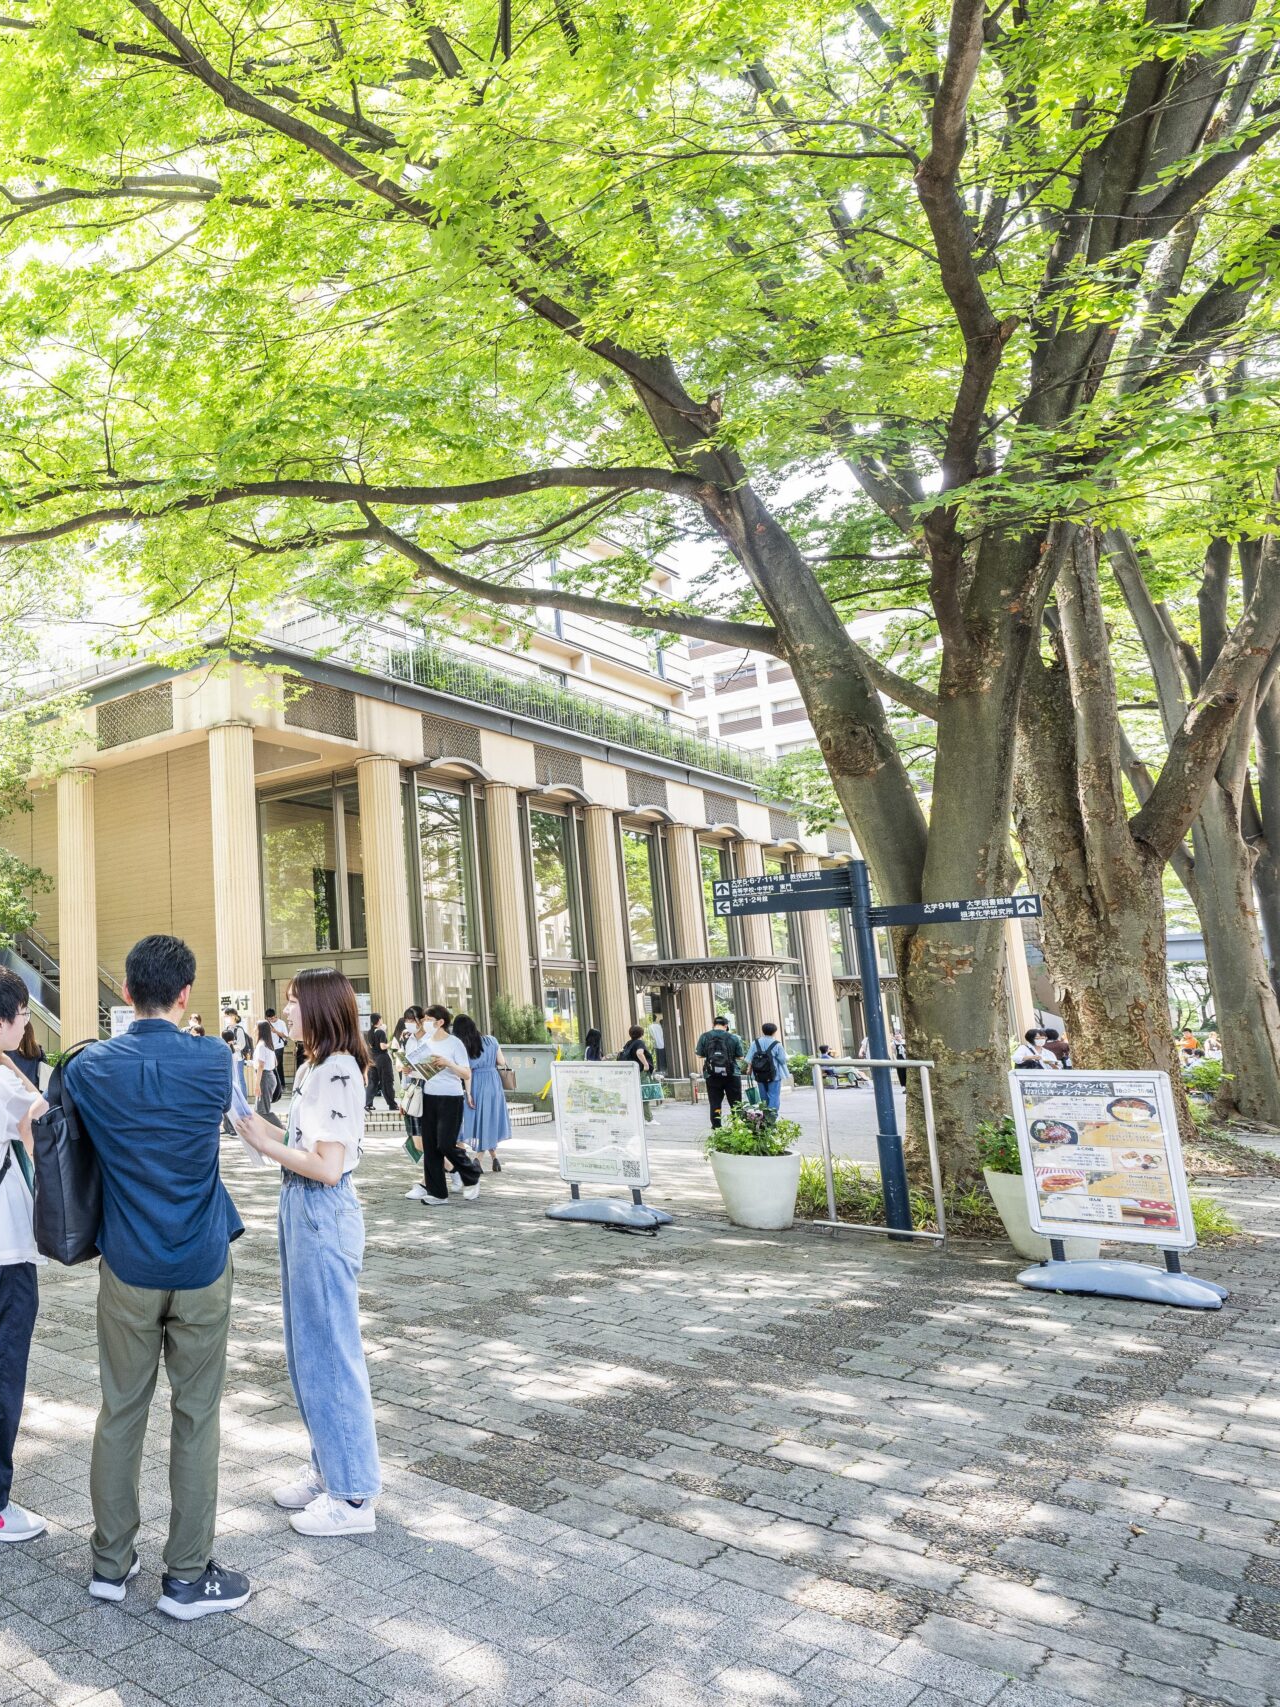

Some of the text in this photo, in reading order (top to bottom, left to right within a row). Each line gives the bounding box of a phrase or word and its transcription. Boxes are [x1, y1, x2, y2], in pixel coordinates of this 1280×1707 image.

[924, 901, 959, 910] 大学9号館
[221, 994, 250, 1011] 受付
